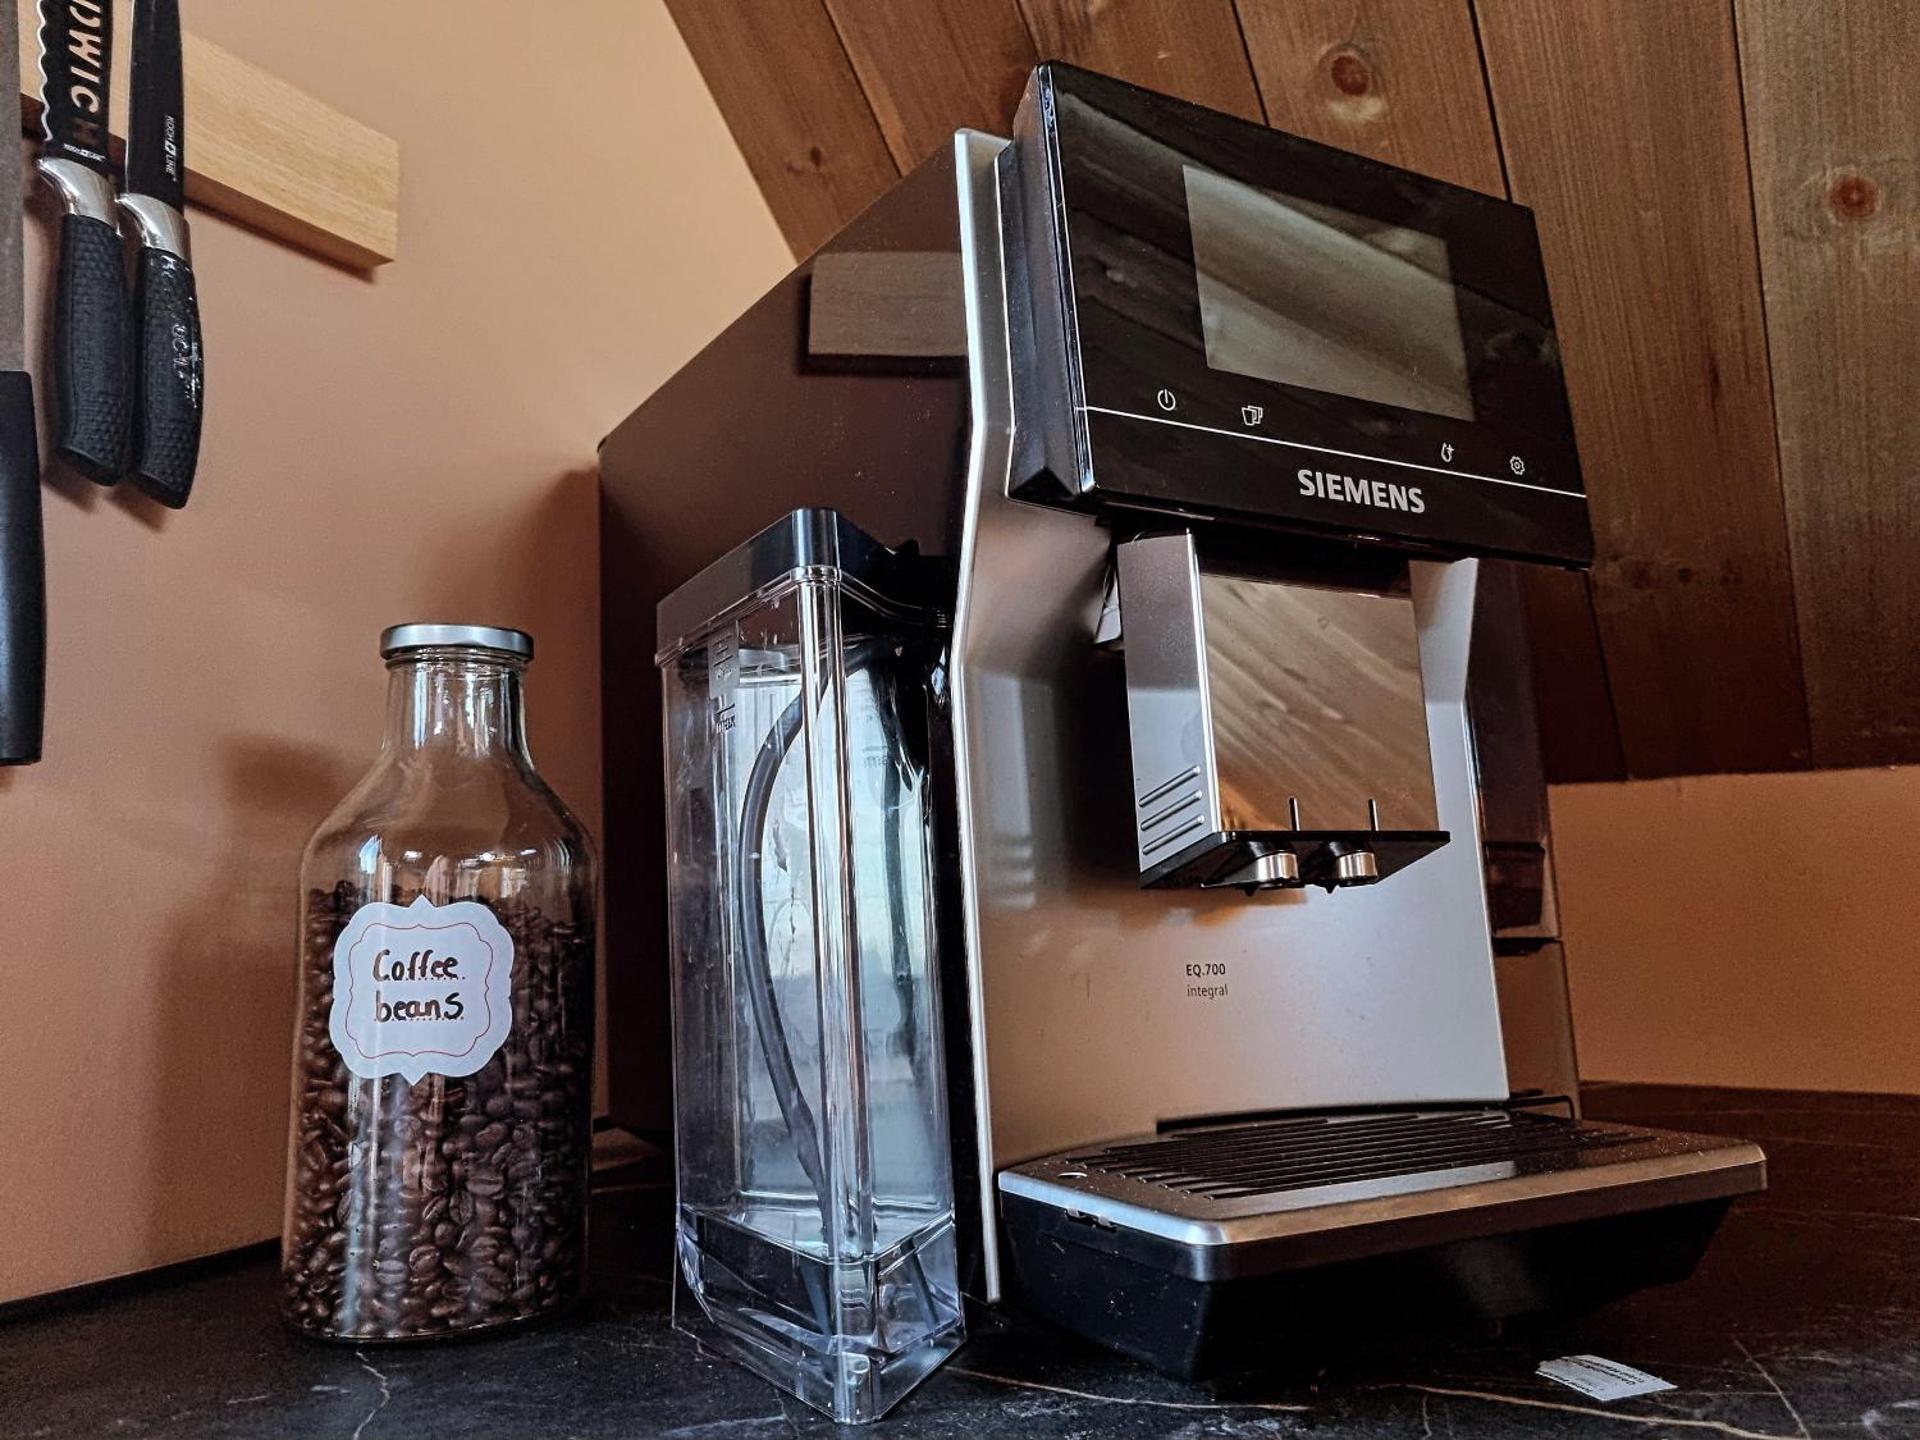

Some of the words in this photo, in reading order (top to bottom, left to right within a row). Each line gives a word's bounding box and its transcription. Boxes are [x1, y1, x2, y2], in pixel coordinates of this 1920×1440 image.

[1297, 469, 1426, 514] SIEMENS
[372, 949, 459, 982] Coffee
[1185, 963, 1226, 978] EQ.700
[375, 989, 465, 1023] beans
[1187, 983, 1229, 1000] integral
